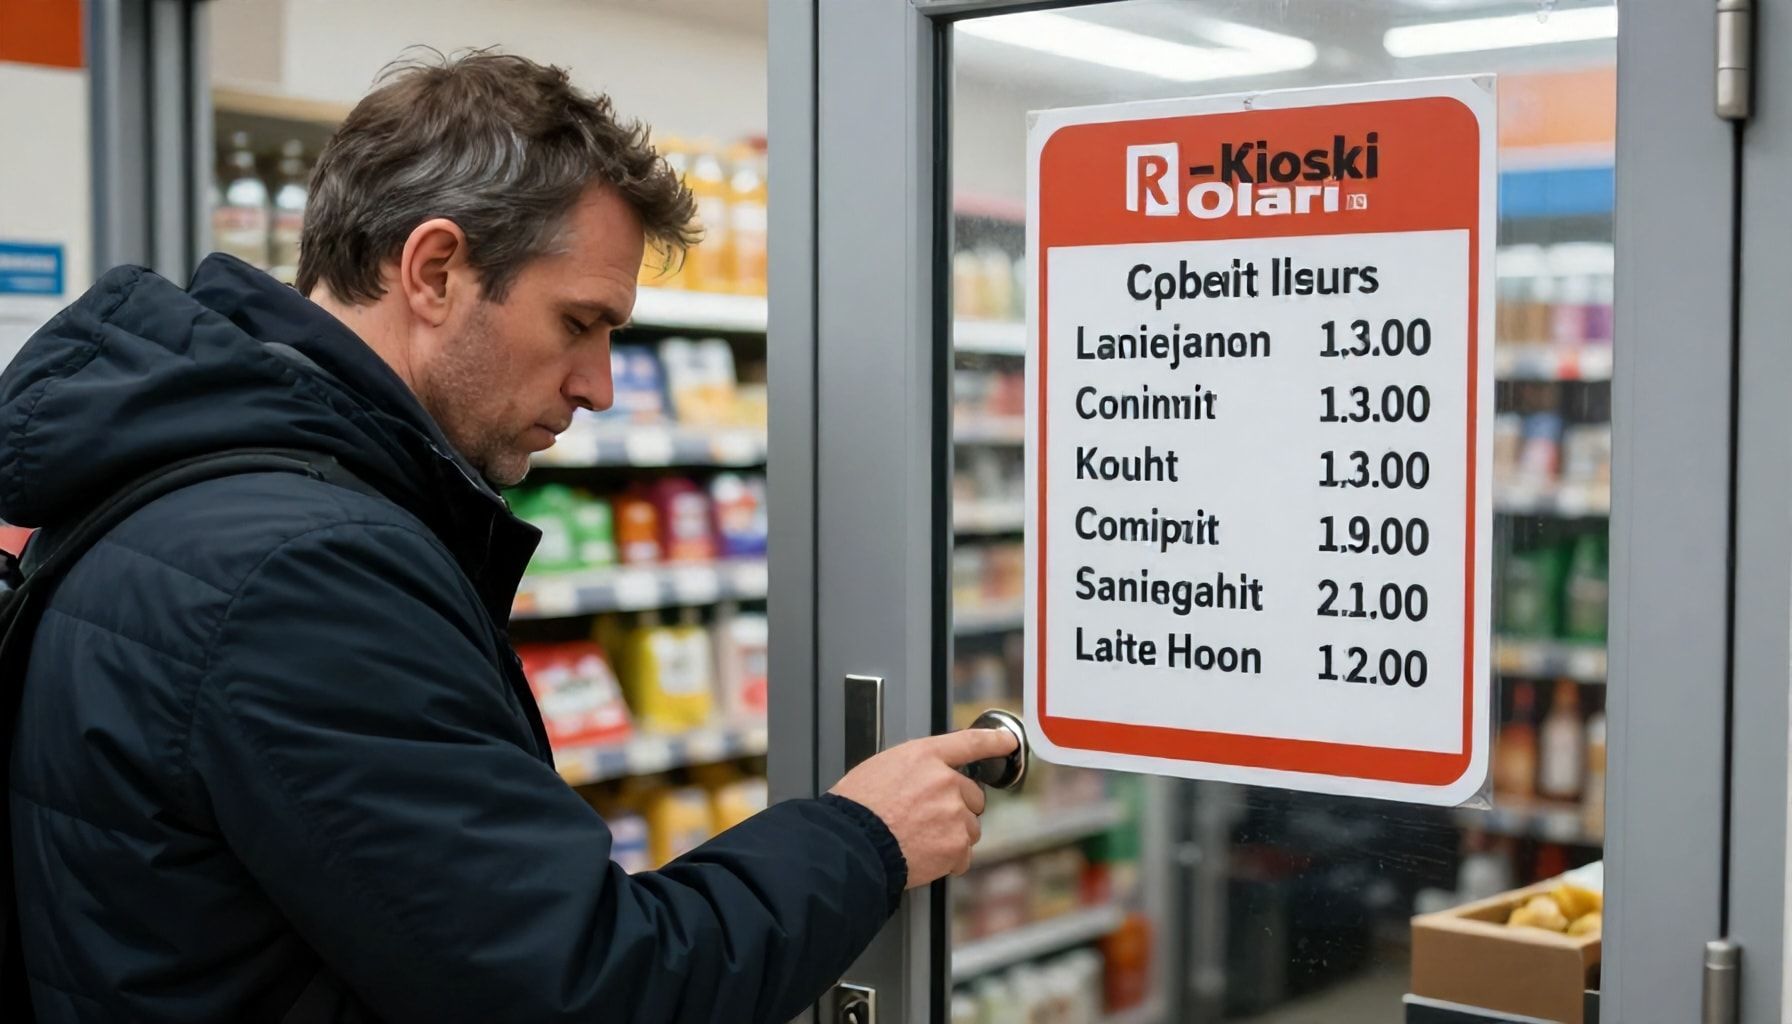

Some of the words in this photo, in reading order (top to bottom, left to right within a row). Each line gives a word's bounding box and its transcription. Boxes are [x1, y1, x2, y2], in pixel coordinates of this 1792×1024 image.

[1076, 323, 1271, 370] Laniejanon
[1319, 384, 1431, 423] 1.3.00
[1076, 446, 1179, 483] Kouht
[1318, 515, 1430, 556] 1.9.00
[1076, 626, 1157, 666] Laite
[1168, 633, 1262, 674] Hoon
